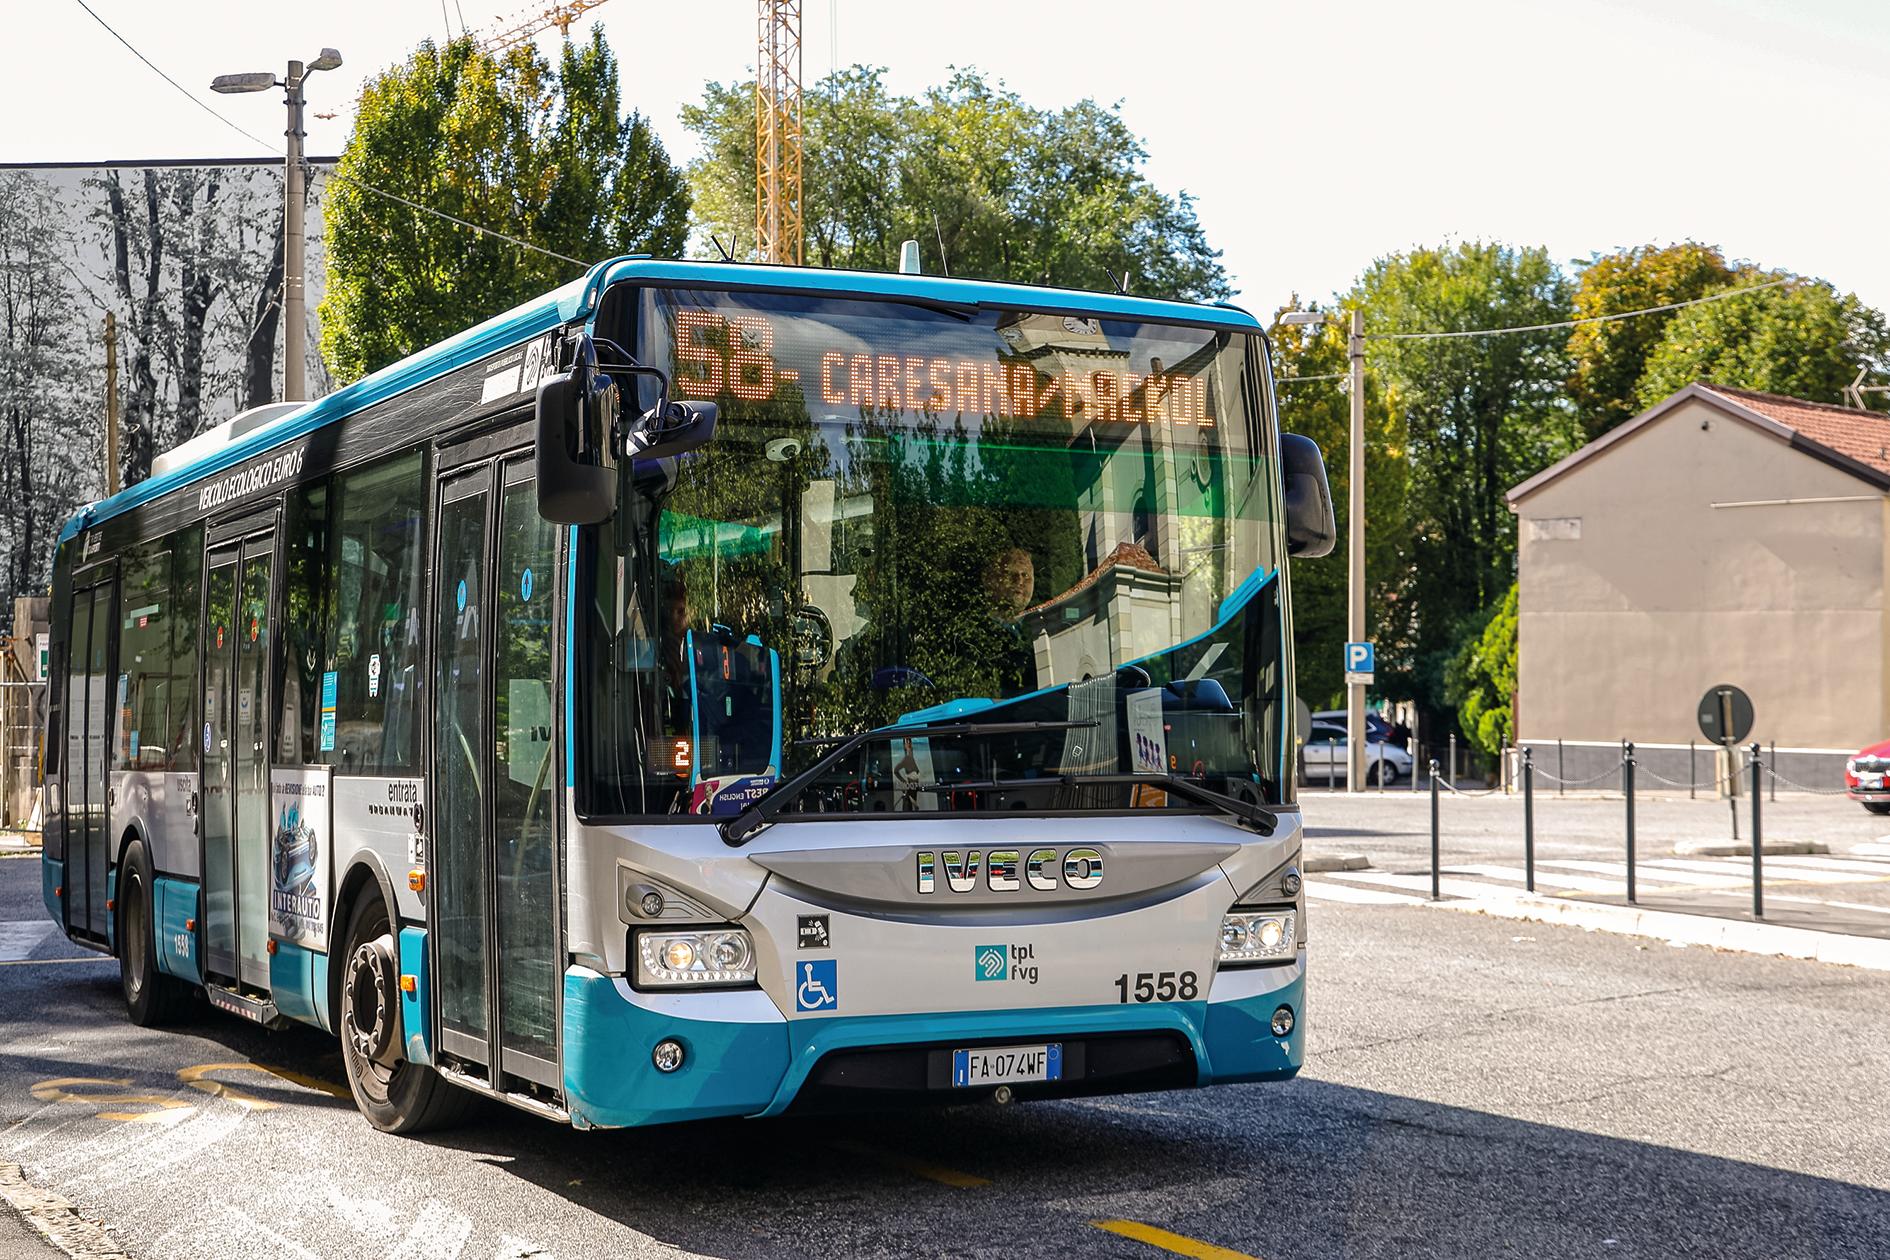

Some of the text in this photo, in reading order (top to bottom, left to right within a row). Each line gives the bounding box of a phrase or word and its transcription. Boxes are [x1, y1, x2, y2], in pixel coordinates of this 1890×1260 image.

[198, 446, 305, 511] VEICOLO ECOLOGICO EURO 6
[1350, 645, 1368, 670] P
[388, 780, 418, 802] entrata
[917, 847, 1105, 894] IVECO
[273, 890, 321, 919] INTERAUTO
[1010, 944, 1035, 964] tpl
[1010, 964, 1038, 984] fvg
[1114, 970, 1199, 1004] 1558
